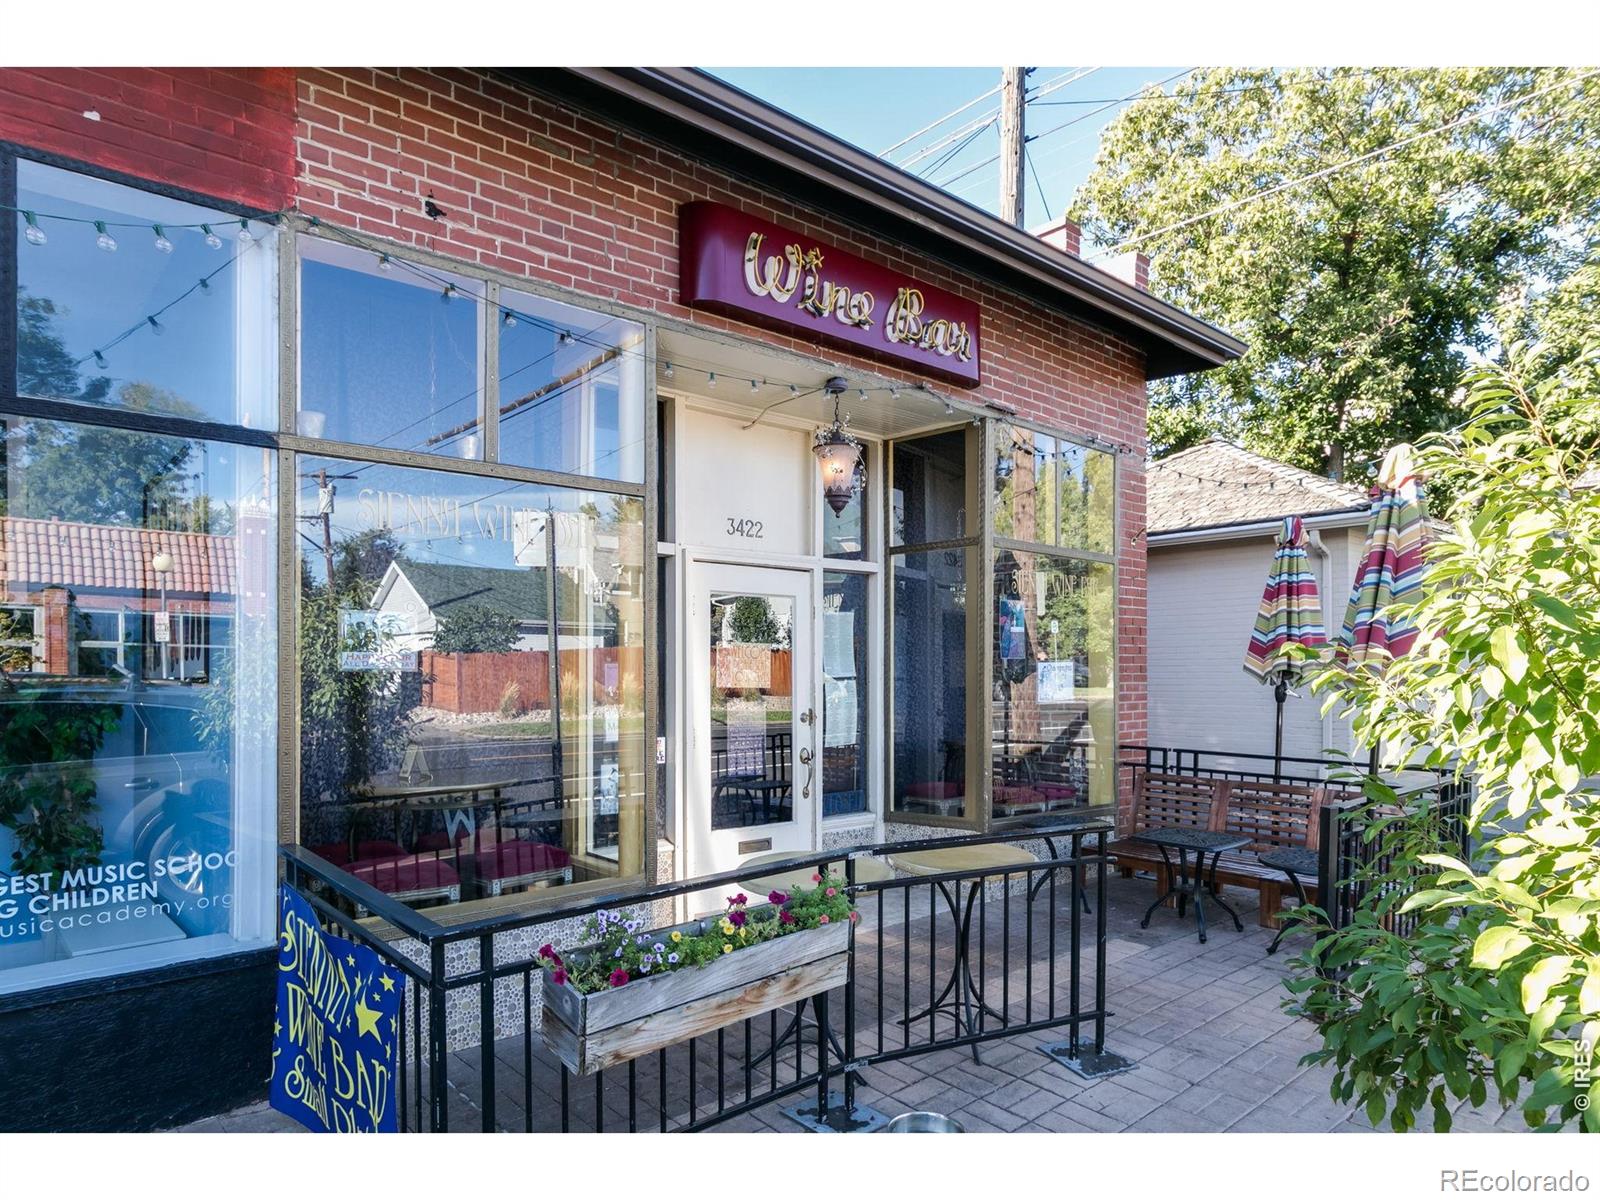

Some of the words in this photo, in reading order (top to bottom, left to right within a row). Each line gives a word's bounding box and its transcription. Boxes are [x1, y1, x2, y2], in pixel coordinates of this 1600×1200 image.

[744, 231, 874, 331] Wine
[886, 287, 972, 363] Bar
[726, 517, 764, 539] 3422
[62, 861, 146, 890] MUSIC
[28, 881, 158, 914] CHILDREN
